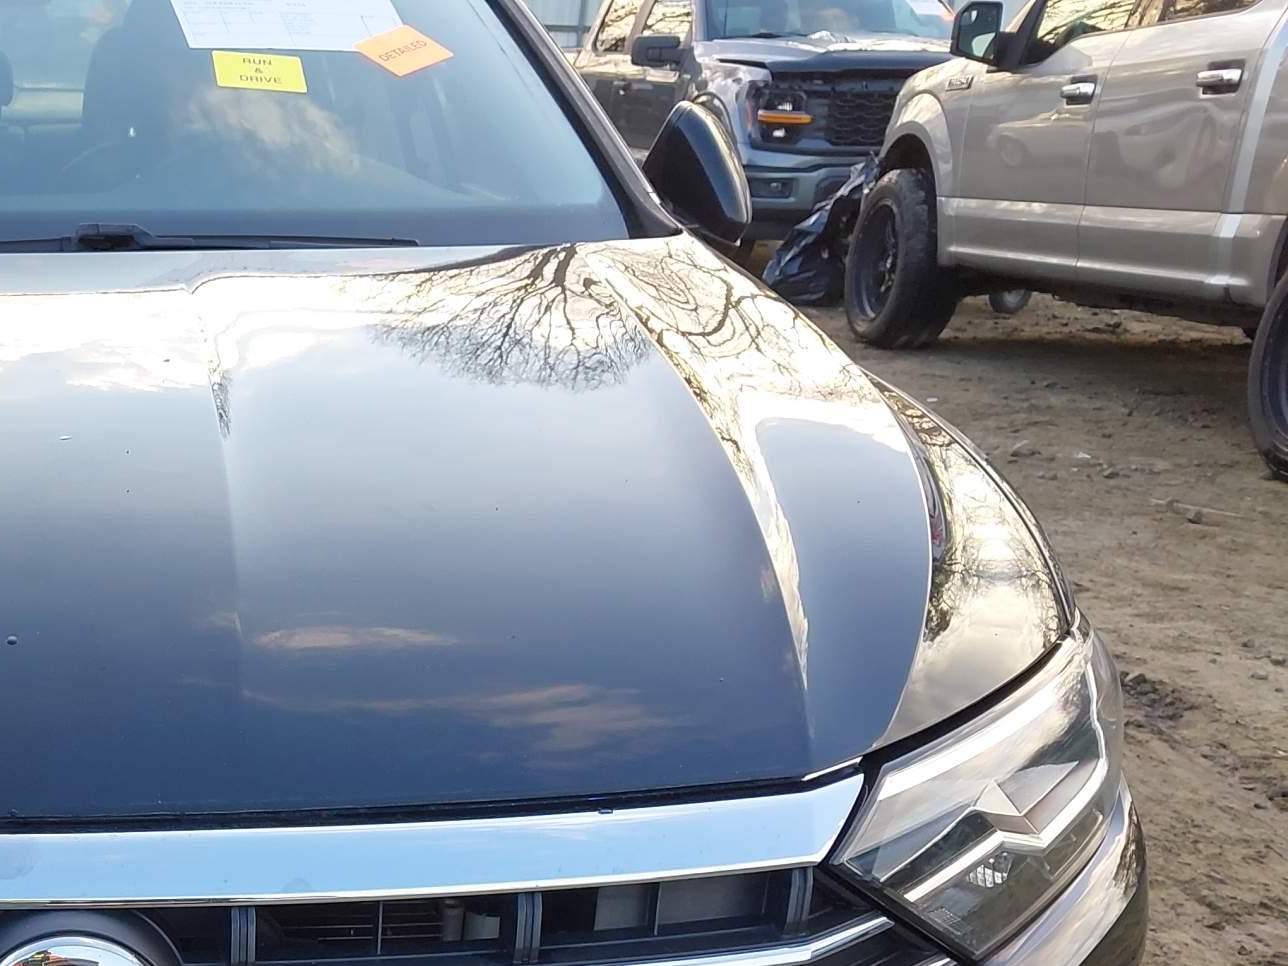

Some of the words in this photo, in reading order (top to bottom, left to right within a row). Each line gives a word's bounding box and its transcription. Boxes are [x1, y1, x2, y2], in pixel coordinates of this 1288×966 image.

[378, 40, 427, 62] DETAILED
[242, 57, 272, 66] RUN
[239, 74, 282, 85] DRIVE
